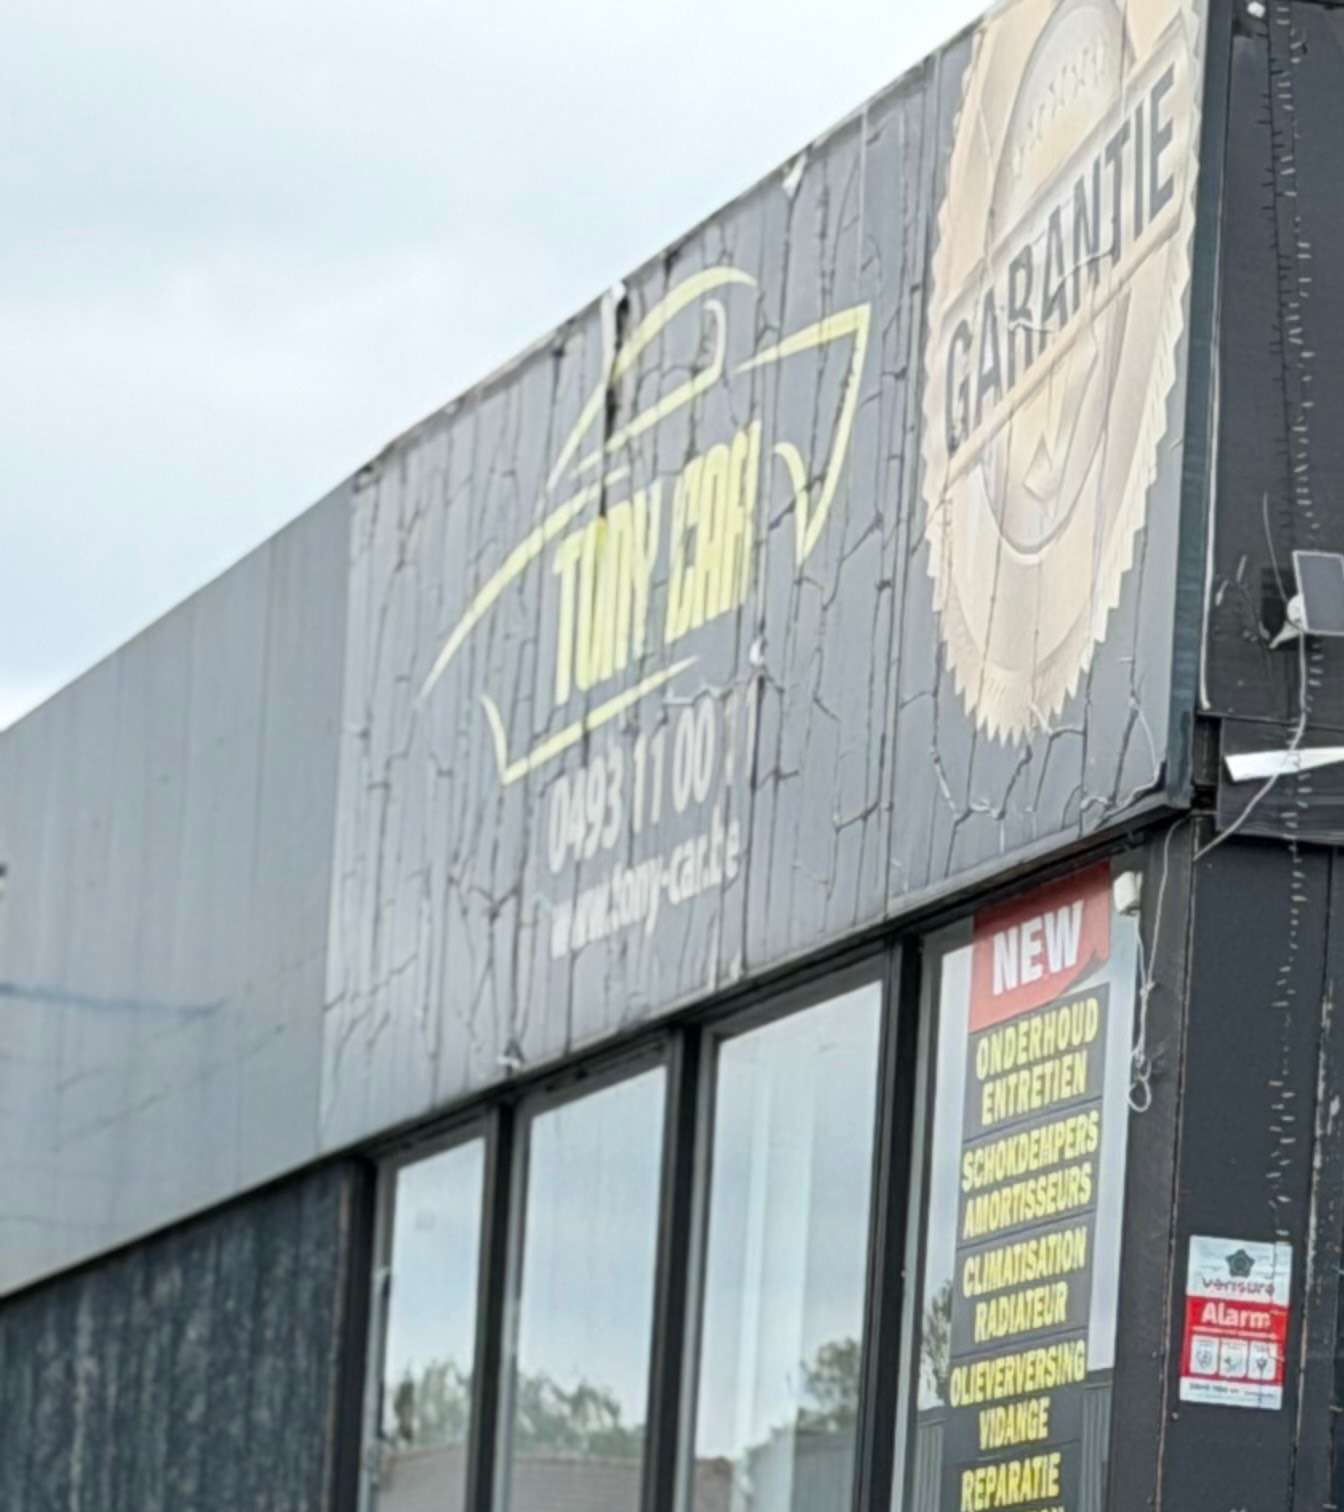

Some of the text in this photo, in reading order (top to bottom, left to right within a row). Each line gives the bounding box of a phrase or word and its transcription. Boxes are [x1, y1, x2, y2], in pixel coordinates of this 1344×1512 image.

[944, 60, 1176, 460] GARANTIE
[992, 899, 1084, 996] NEW
[976, 997, 1099, 1081] ONDERHOUD
[981, 1049, 1088, 1126] ENTRETIEN
[962, 1111, 1099, 1192] SCHOKDEMPERS
[962, 1165, 1093, 1241] AMORTISSEURS
[963, 1226, 1087, 1298] CLIMATISATION
[973, 1283, 1068, 1344] RADIATEUR
[1202, 1301, 1271, 1329] Alarm
[949, 1340, 1087, 1409] OLIEVERVERSING
[977, 1397, 1050, 1452] VIDANGE
